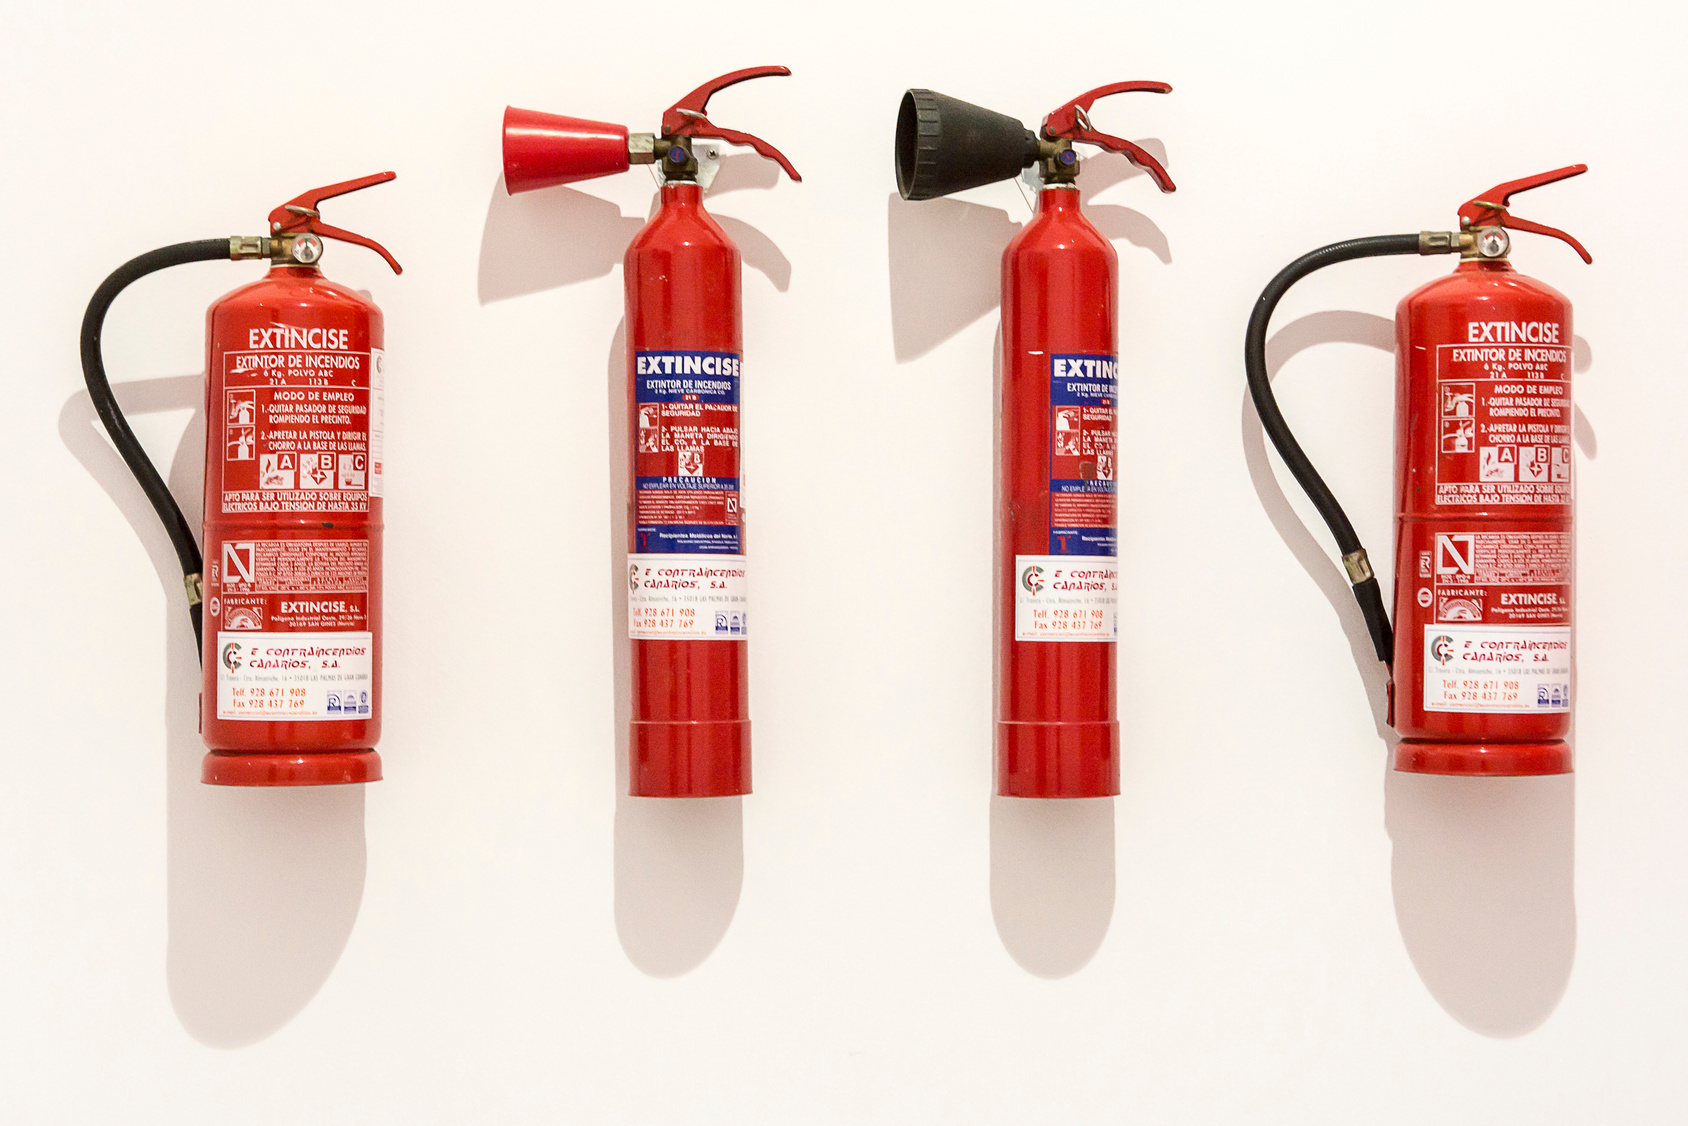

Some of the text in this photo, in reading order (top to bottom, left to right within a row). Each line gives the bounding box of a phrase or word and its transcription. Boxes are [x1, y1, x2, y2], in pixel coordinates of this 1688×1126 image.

[1468, 321, 1559, 343] EXTINCISE
[249, 328, 348, 349] EXTINCISE
[1453, 349, 1566, 363] EXTINTOR DE INCENDIOS
[236, 355, 360, 369] EXTINTOR DE INCENDIOS
[637, 356, 739, 376] EXTINCISE
[647, 380, 732, 390] EXTINTOR DE INCENDIOS
[1067, 383, 1108, 392] EXTINTOR DE
[1494, 385, 1563, 395] MODO DE EMPLEO
[274, 392, 354, 401] MODO DE EMPLEO
[1516, 398, 1542, 407] PASADOR
[295, 404, 326, 413] PASADOR
[328, 404, 336, 413] DE
[1490, 408, 1536, 417] ROMPIENDO EL
[269, 415, 310, 424] ROMPIENDO
[312, 415, 319, 423] EL
[1520, 425, 1526, 433] LA
[1528, 425, 1548, 433] PISTOLA
[300, 431, 341, 439] LA PISTOLA Y
[1489, 434, 1543, 444] CHORRO A LA BASE
[269, 441, 346, 451] CHORRO A LA BASE DE LAS
[694, 453, 700, 463] B
[1501, 448, 1513, 461] A
[1538, 449, 1547, 461] B
[280, 455, 364, 469] A B C
[1439, 485, 1457, 493] APTO
[1460, 485, 1479, 493] PARA
[1482, 485, 1495, 493] SER
[1497, 485, 1534, 494] UTILIZADO
[242, 493, 259, 501] PARA
[262, 493, 275, 501] SER
[277, 493, 316, 501] UTILIZADO
[319, 493, 341, 501] SOBRE
[1479, 494, 1499, 503] BAJO
[1502, 495, 1532, 503] TENSION
[1534, 495, 1541, 503] DE
[259, 502, 279, 510] BAJO
[282, 502, 314, 510] TENSION
[317, 502, 325, 510] DE
[328, 502, 349, 510] HASTA
[645, 608, 695, 617] 928 671 908
[1054, 610, 1103, 618] 928 671 908
[644, 619, 656, 628] 928
[660, 620, 673, 628] 437
[679, 620, 693, 628] 769
[1034, 621, 1102, 629] Fax 928 437 769
[322, 660, 341, 668] S.A.
[1463, 680, 1519, 690] 928 671 908
[250, 688, 306, 697] 928 671 908
[1443, 691, 1517, 701] Fax 928 437 769
[233, 699, 304, 708] Fax 928 437 769
